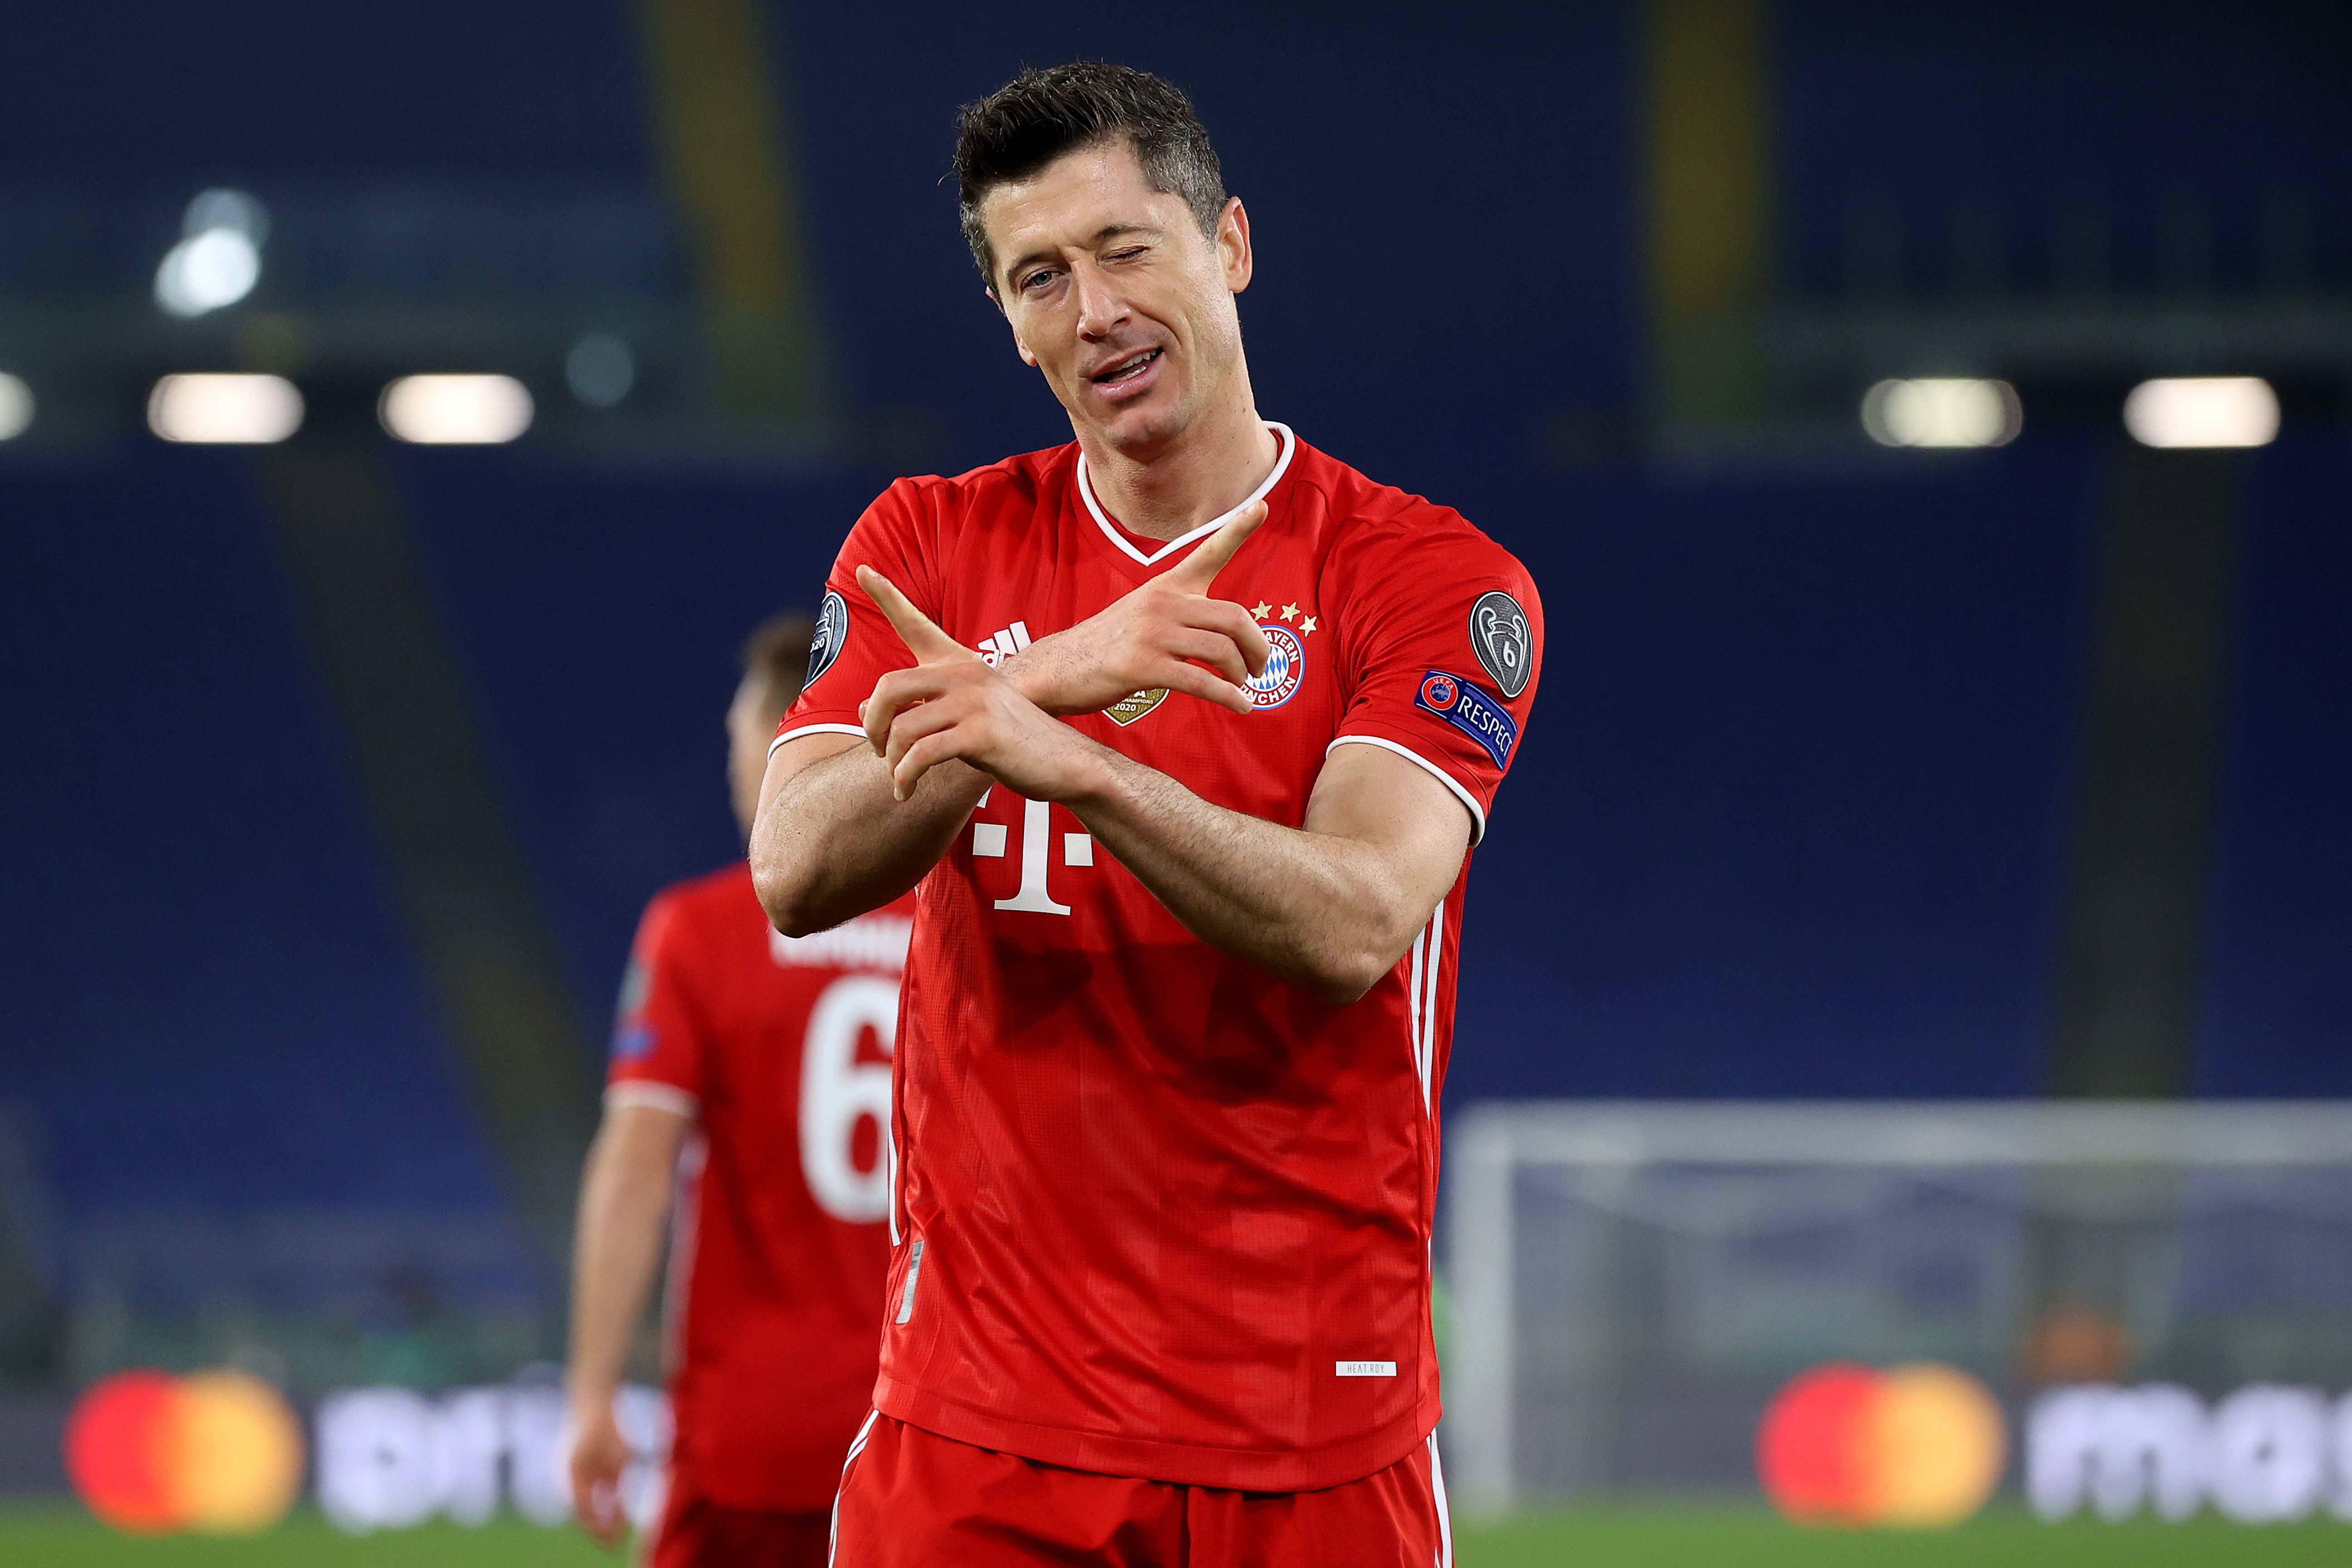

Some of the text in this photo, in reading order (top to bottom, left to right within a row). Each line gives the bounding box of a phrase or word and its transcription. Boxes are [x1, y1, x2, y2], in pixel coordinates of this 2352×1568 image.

[1266, 631, 1299, 663] AYERN
[1503, 642, 1516, 667] 6
[1240, 676, 1296, 704] ÜNCHEN
[1433, 678, 1454, 690] UEFA
[1113, 703, 1137, 711] 2020
[1457, 695, 1512, 756] RESPECT
[798, 974, 901, 1224] 6
[1347, 1364, 1384, 1373] HEAT.RDY
[2026, 1384, 2352, 1524] ma
